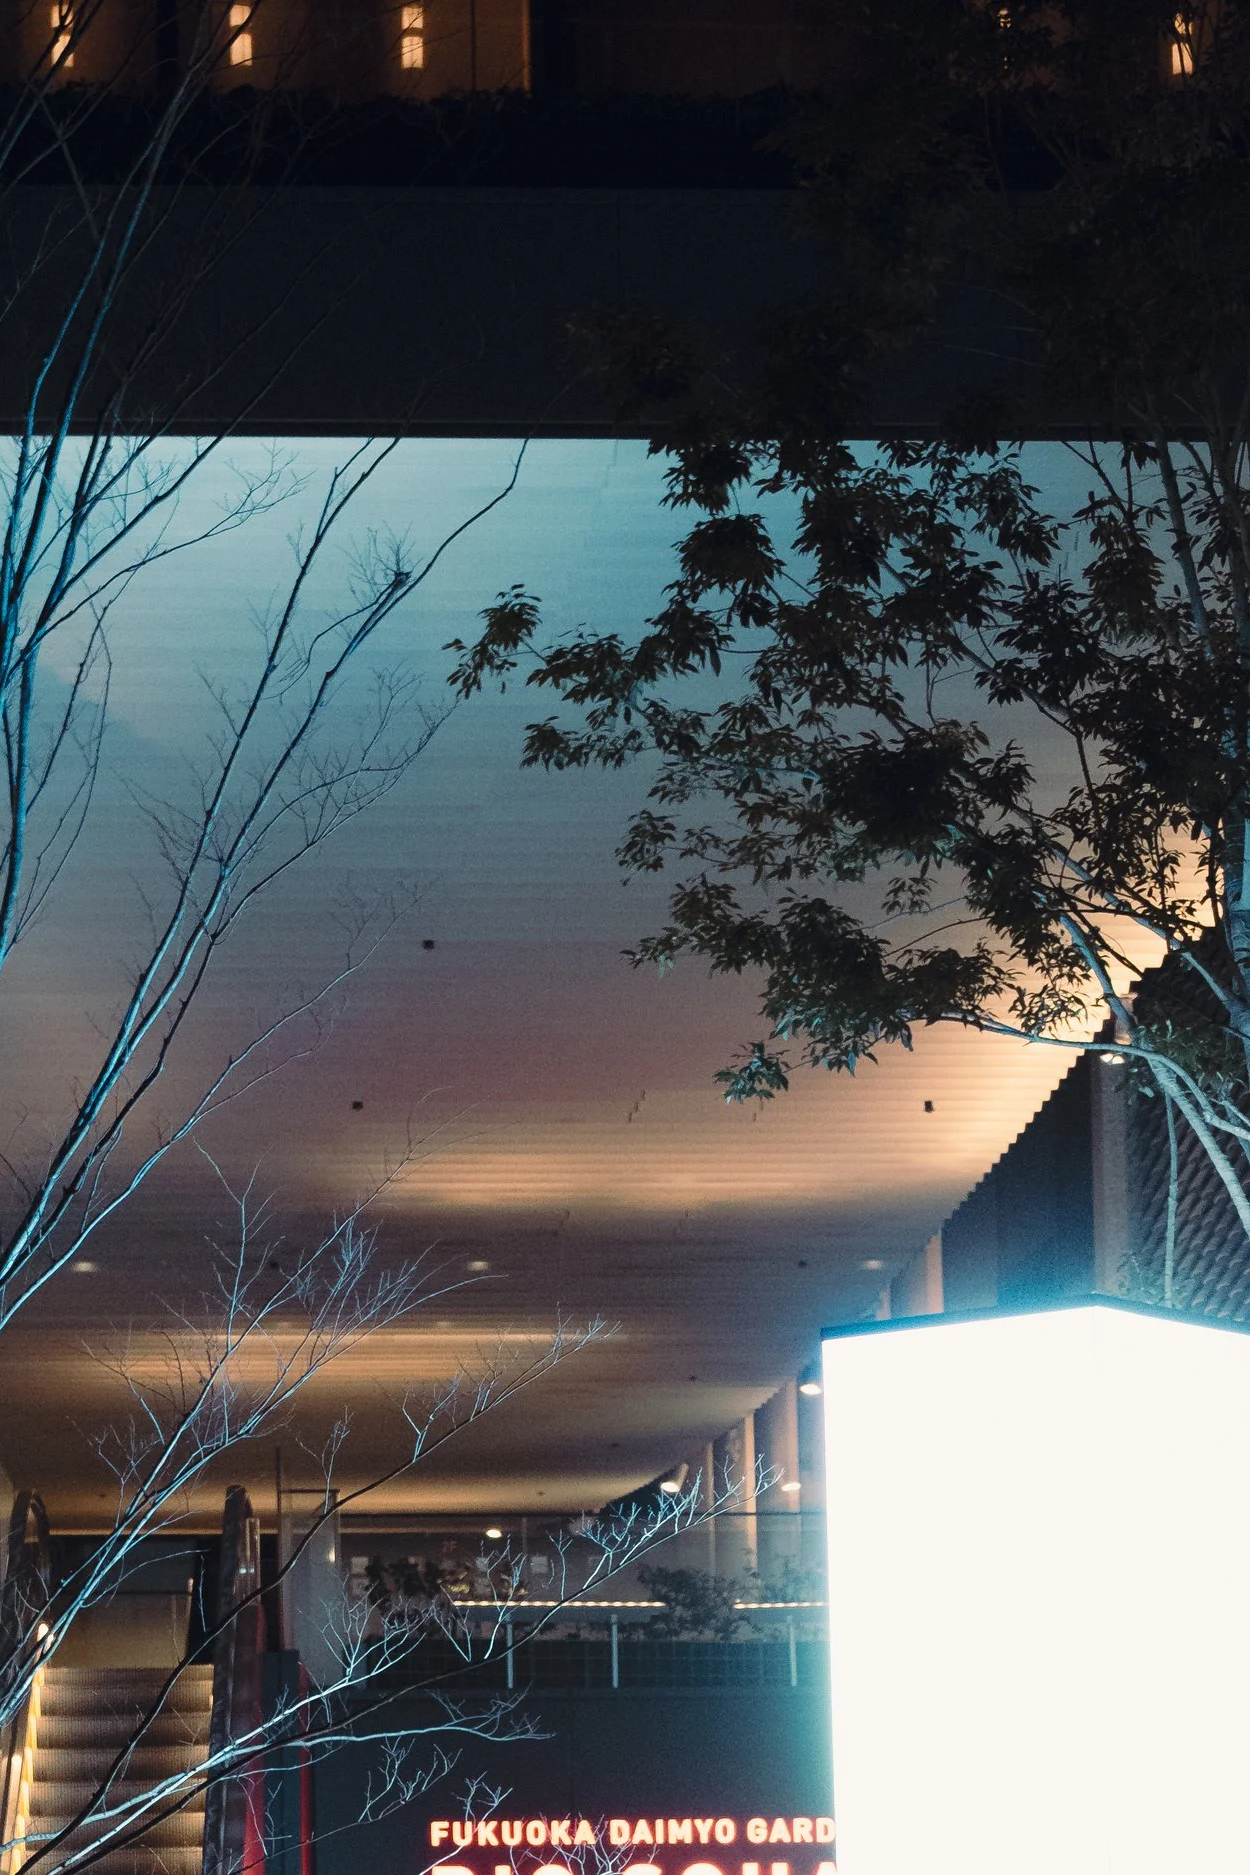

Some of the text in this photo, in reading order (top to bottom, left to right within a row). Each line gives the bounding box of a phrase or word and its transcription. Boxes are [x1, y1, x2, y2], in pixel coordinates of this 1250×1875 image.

[430, 1816, 835, 1848] FUKUOKA DAIMYO GARD
